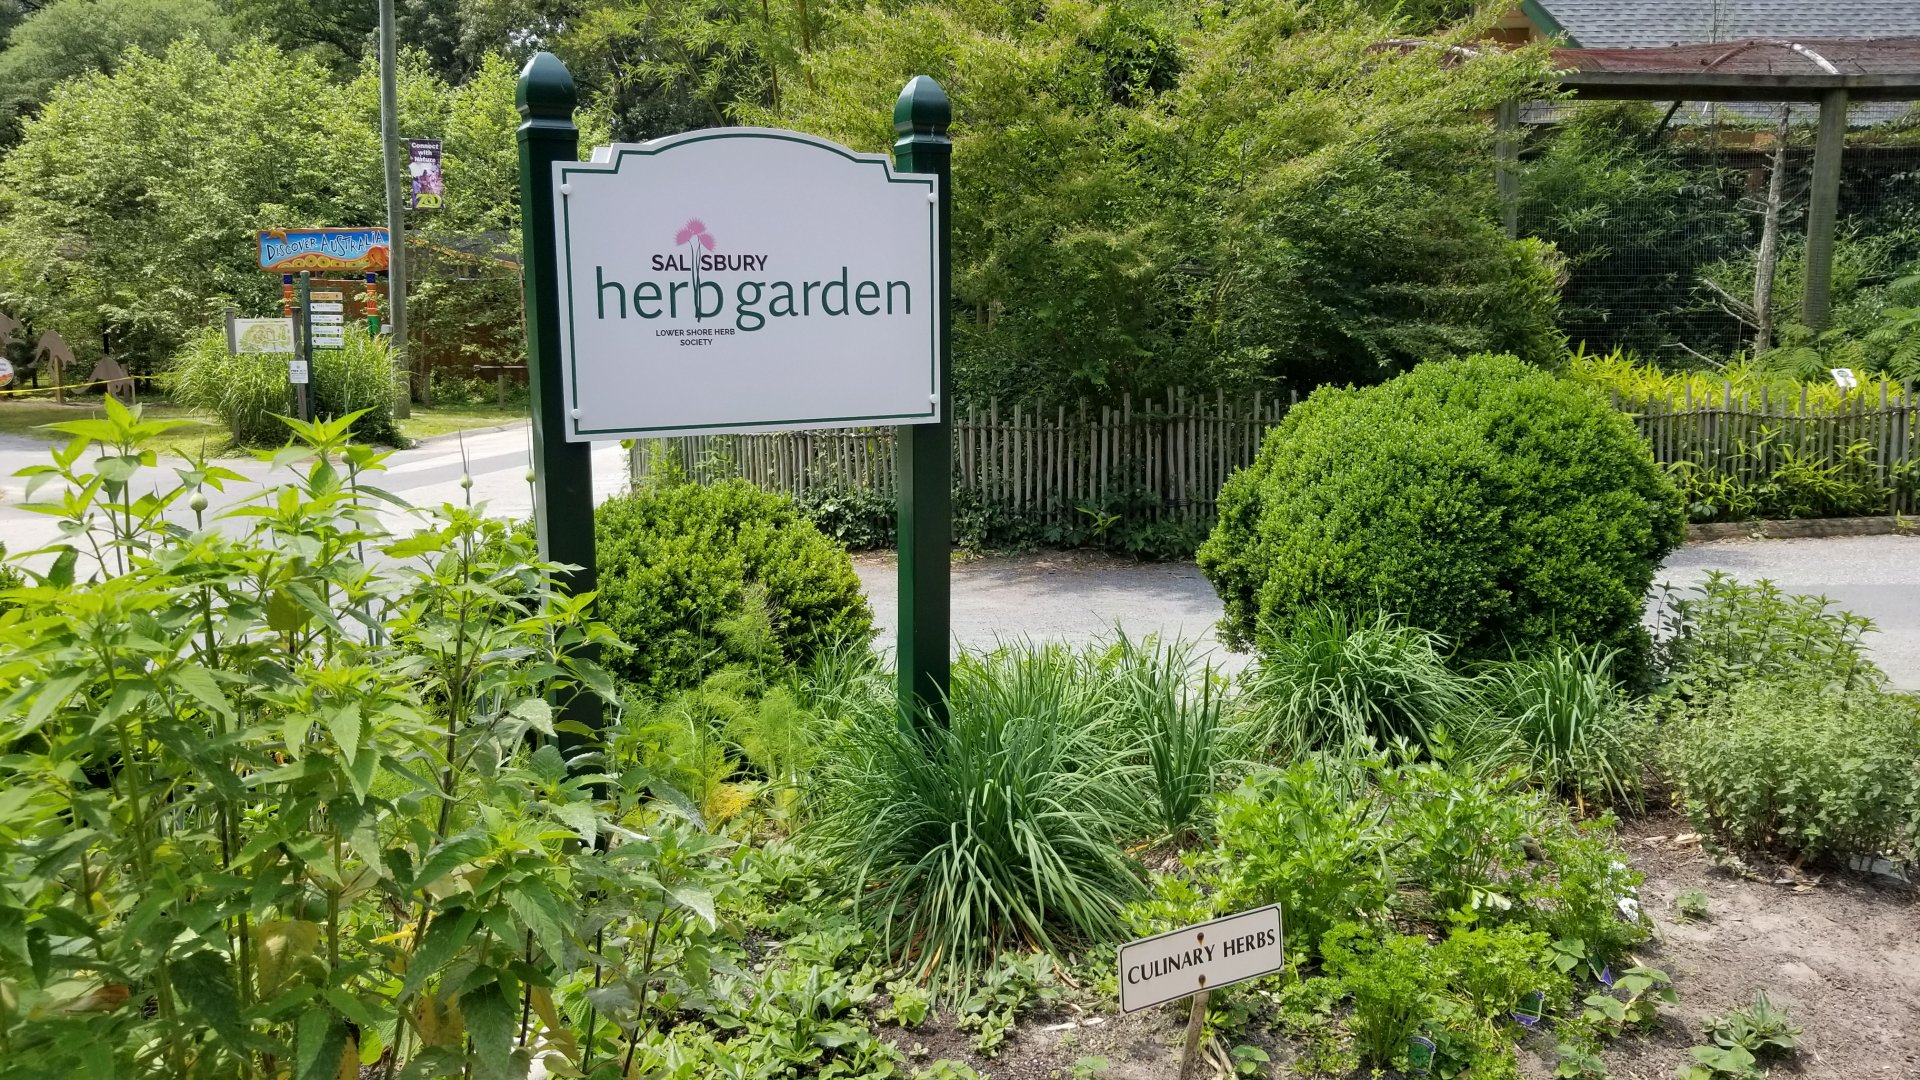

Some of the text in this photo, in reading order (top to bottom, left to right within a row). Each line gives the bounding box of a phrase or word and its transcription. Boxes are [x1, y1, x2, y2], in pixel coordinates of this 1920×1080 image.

[416, 193, 442, 208] ZOO
[595, 265, 912, 332] herb garden
[655, 329, 685, 337] LOWER
[686, 328, 713, 336] SHORE
[680, 338, 713, 346] SOCIETY
[1127, 928, 1276, 985] CULINARY HERBS
